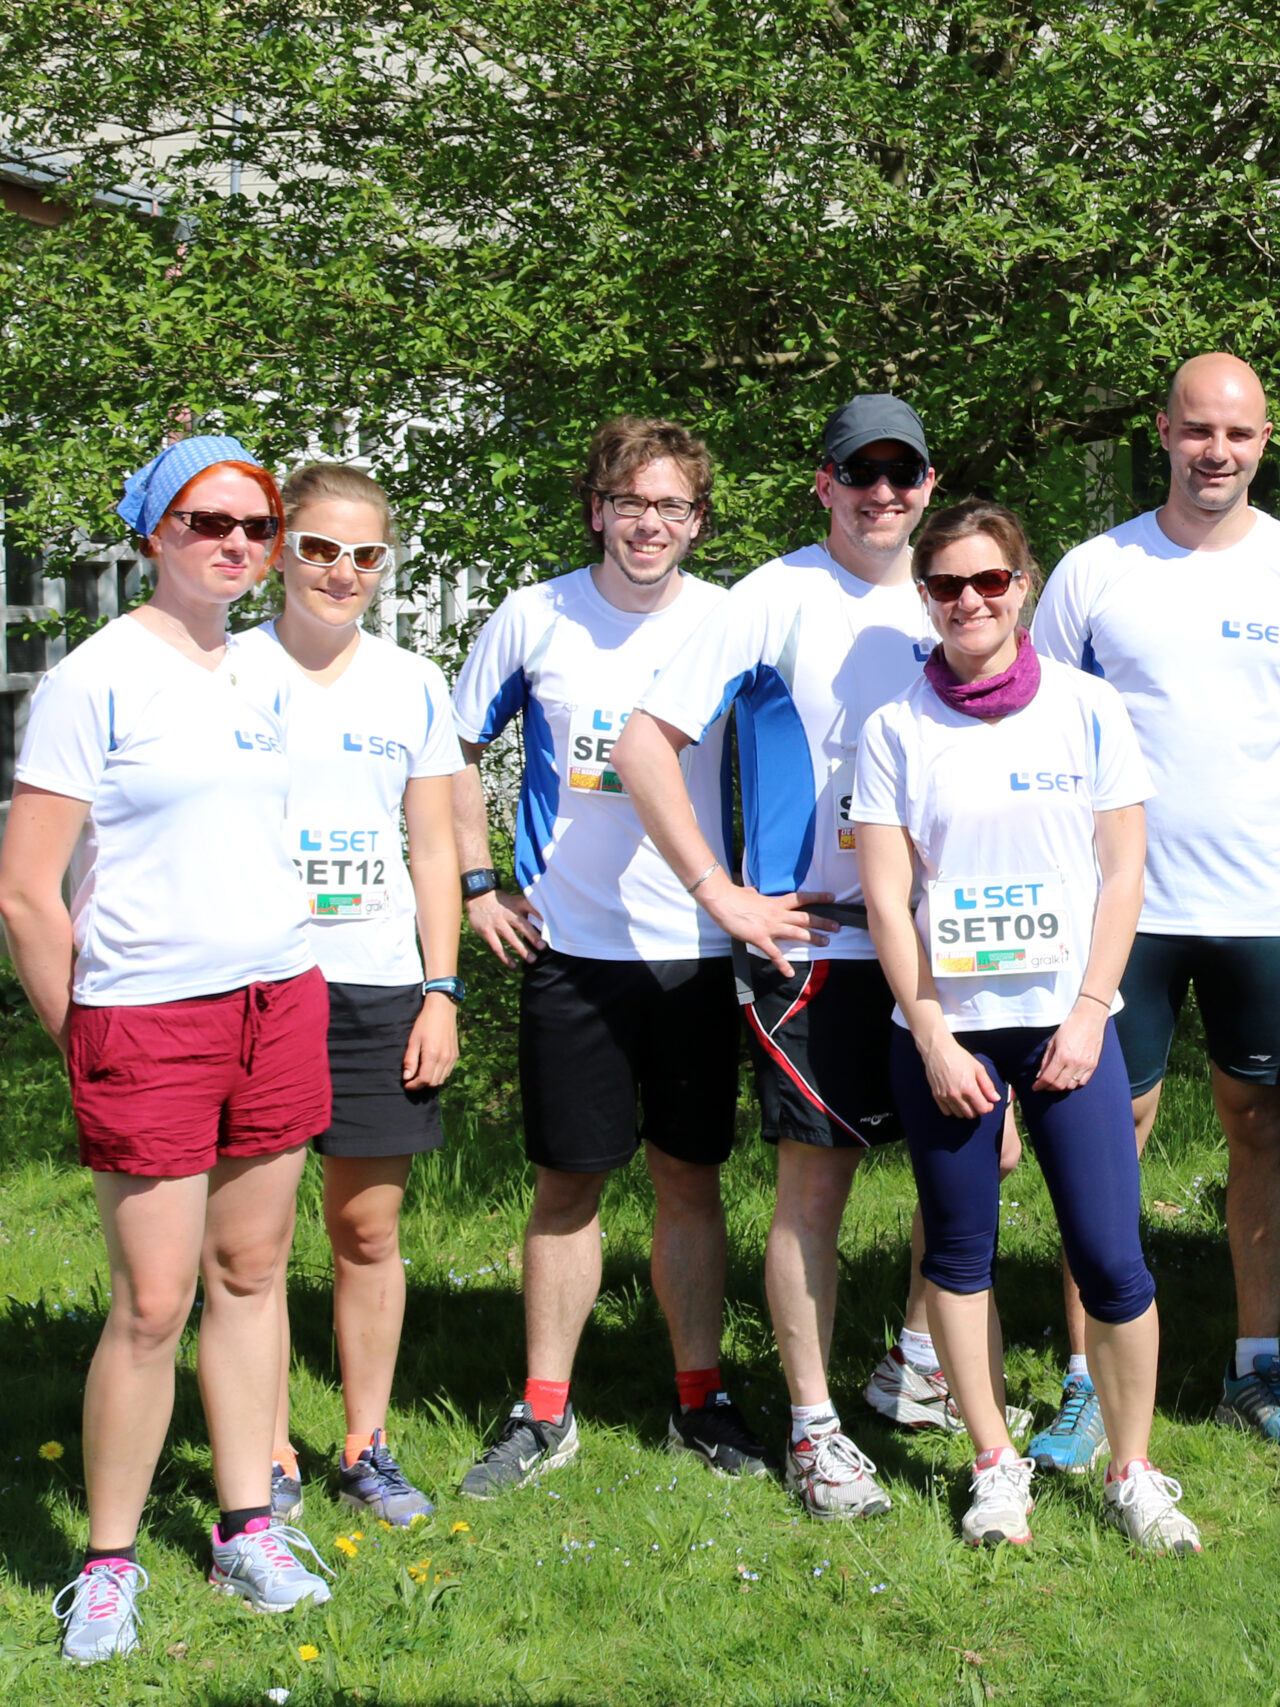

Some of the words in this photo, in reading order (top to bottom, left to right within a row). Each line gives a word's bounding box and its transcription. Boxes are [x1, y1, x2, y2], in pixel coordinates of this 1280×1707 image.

[368, 735, 408, 763] SET
[1036, 771, 1084, 794] SET
[329, 830, 379, 852] SET
[983, 883, 1044, 909] SET
[937, 912, 1059, 945] SET09
